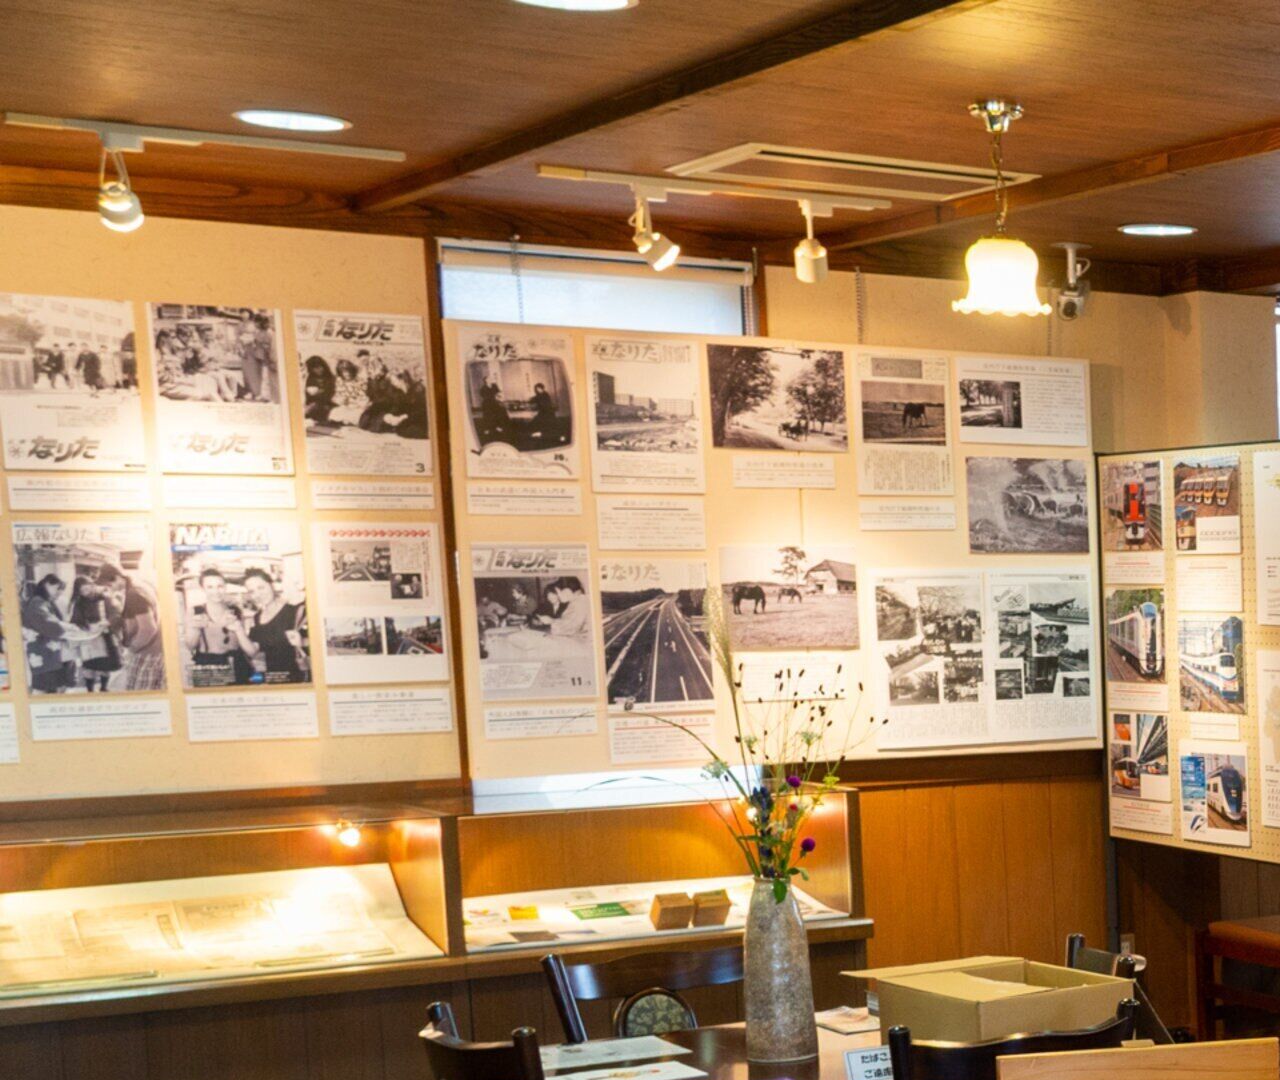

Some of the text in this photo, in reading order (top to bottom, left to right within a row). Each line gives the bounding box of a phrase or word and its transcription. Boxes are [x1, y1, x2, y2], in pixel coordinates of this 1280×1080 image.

[336, 319, 395, 341] なりた
[610, 341, 658, 362] なりた
[27, 435, 102, 463] なりた
[186, 431, 249, 457] なりた
[416, 463, 425, 473] 3
[507, 550, 559, 569] なりた
[611, 563, 661, 582] なりた
